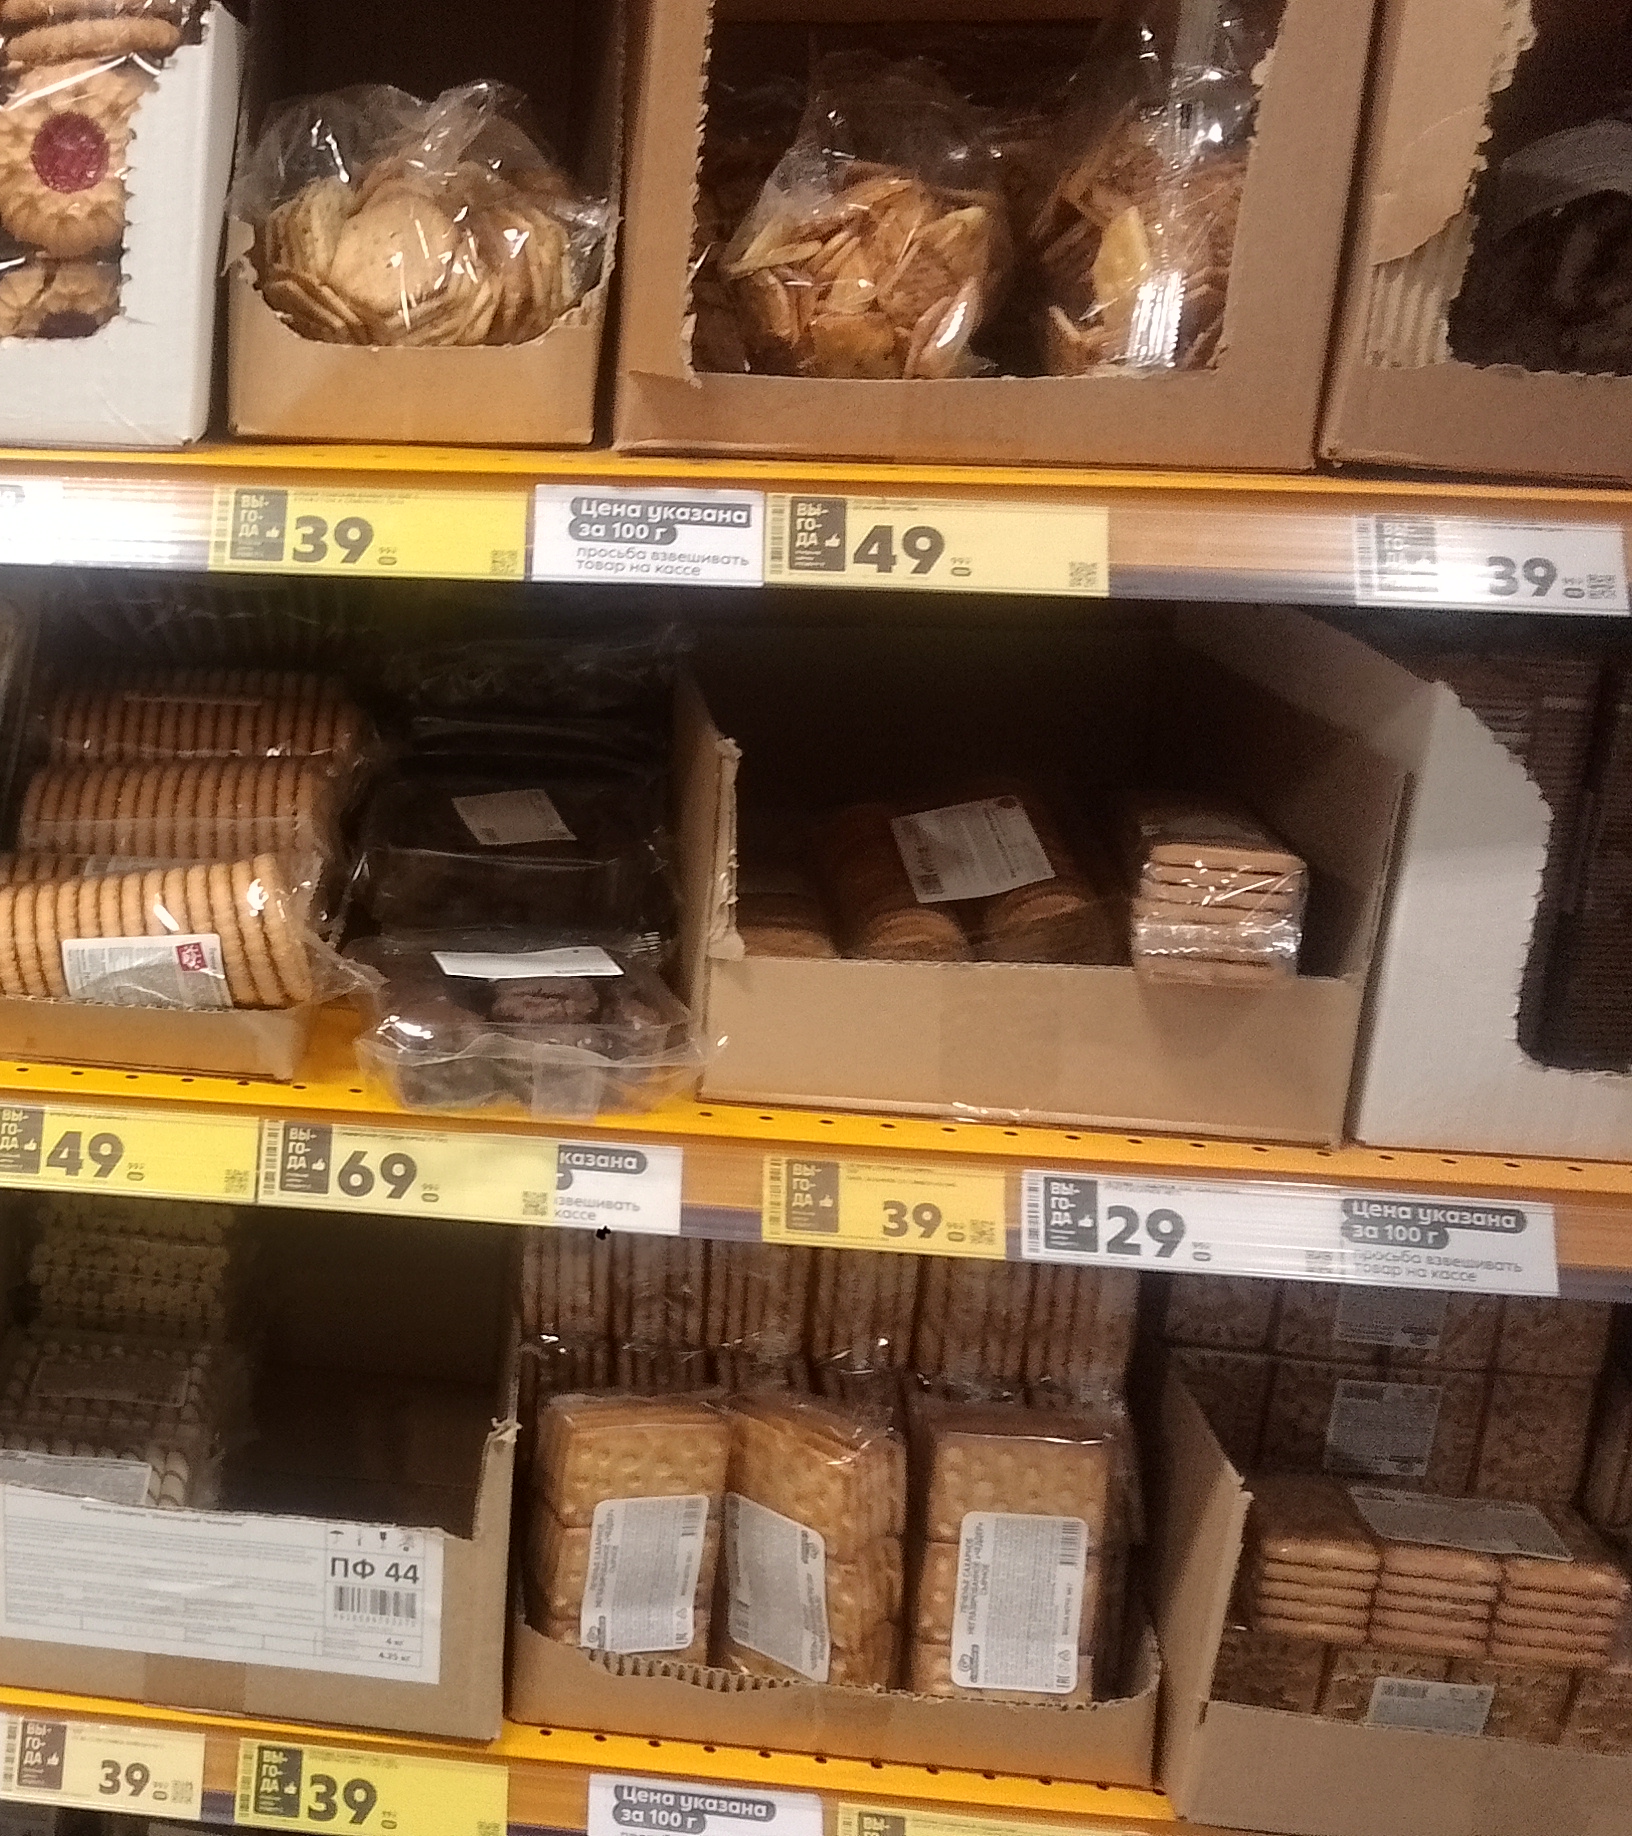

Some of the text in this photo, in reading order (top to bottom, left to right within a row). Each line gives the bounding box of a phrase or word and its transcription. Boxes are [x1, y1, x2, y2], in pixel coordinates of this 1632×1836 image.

[581, 499, 748, 524] Цена указана
[292, 515, 374, 563] 39
[579, 523, 667, 540] за 100 г
[853, 525, 945, 574] 49
[1487, 556, 1557, 597] 39
[46, 1130, 125, 1178] 49
[559, 1152, 638, 1169] казана
[338, 1151, 417, 1199] 69
[555, 1197, 640, 1212] звешивать
[883, 1200, 942, 1238] 39
[1352, 1201, 1516, 1228] Цена указана
[1106, 1205, 1186, 1258] 29
[1352, 1224, 1439, 1244] за 100 г
[330, 1556, 420, 1584] ПФ 44
[99, 1760, 151, 1796] 39
[308, 1774, 377, 1825] 39
[622, 1787, 767, 1817] Цена указана
[621, 1809, 698, 1828] за 100 г
